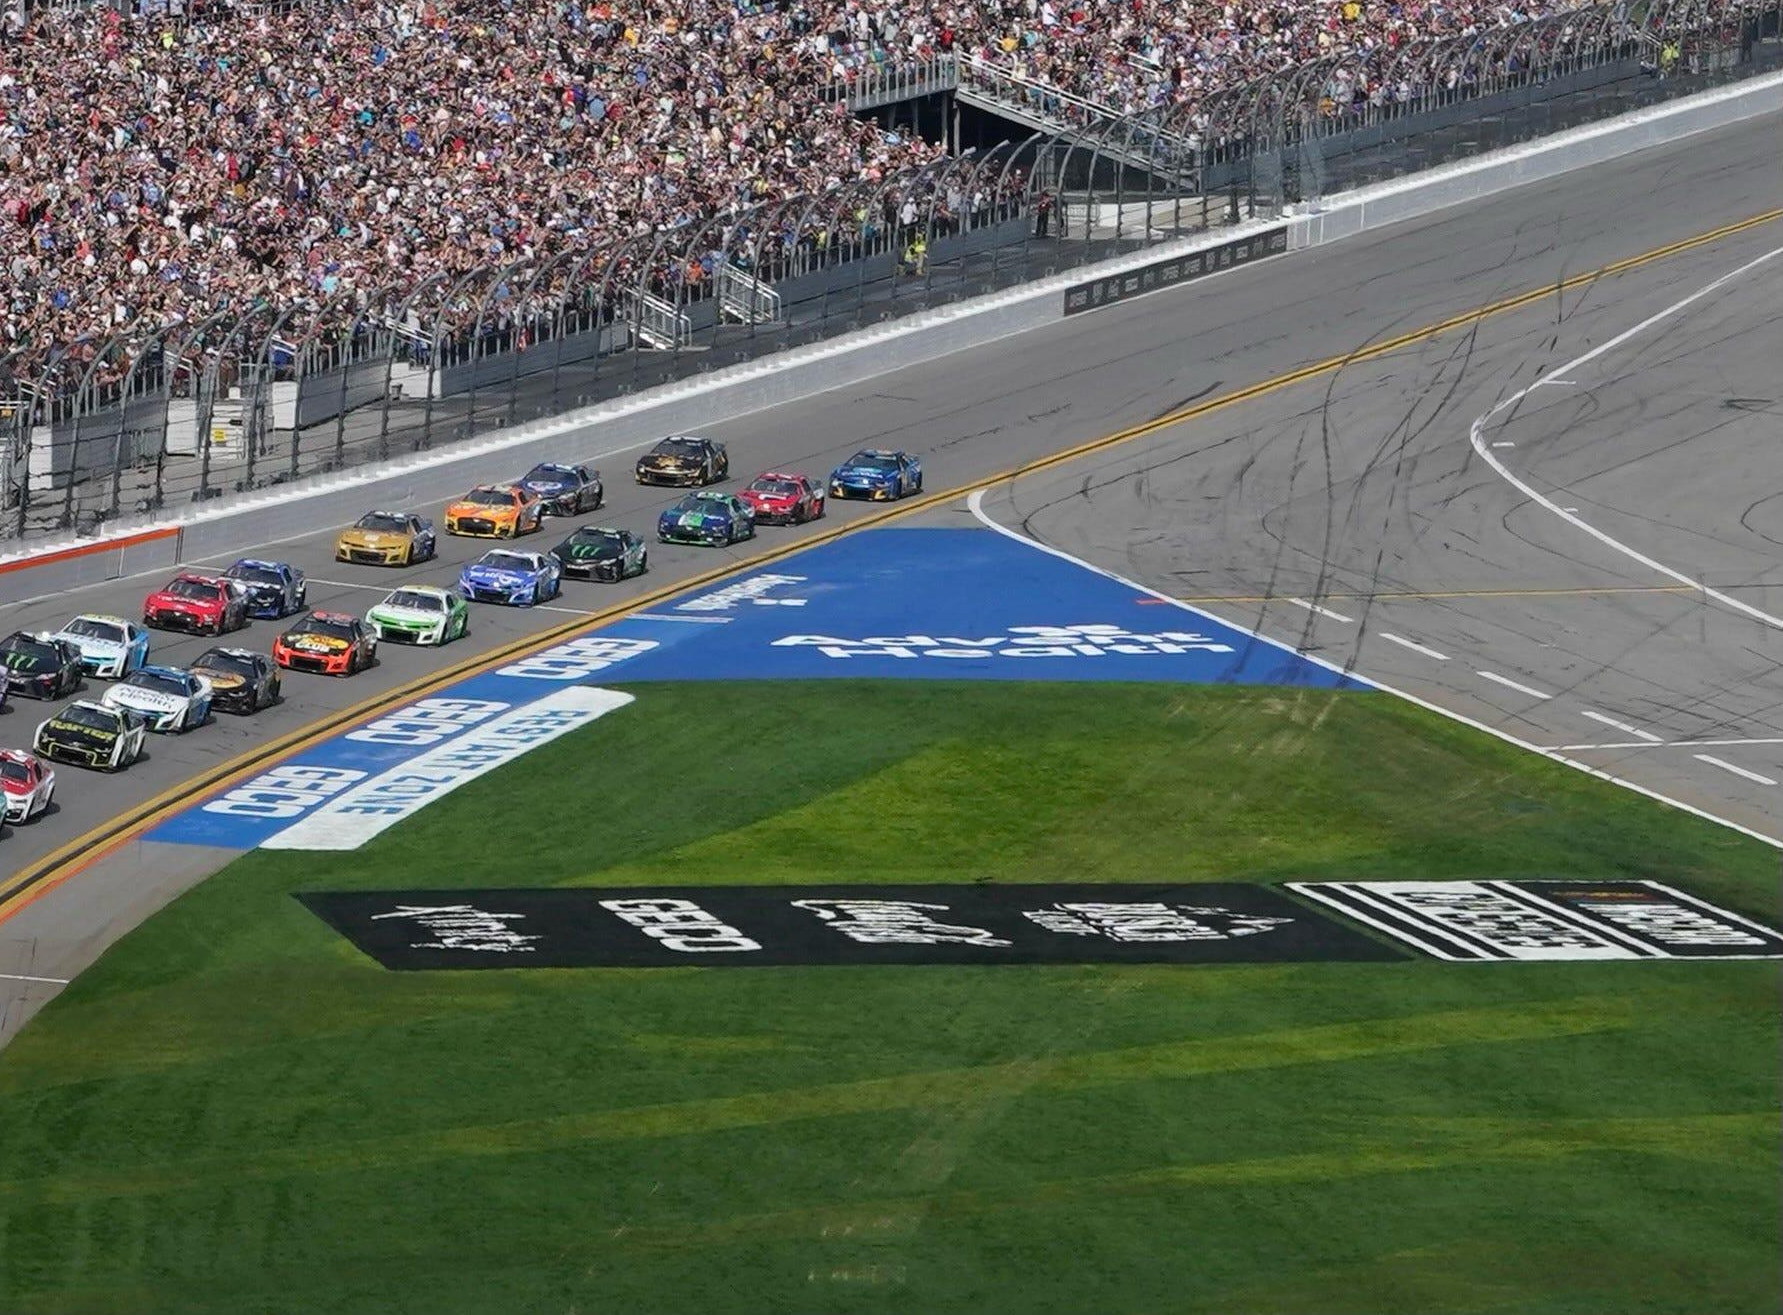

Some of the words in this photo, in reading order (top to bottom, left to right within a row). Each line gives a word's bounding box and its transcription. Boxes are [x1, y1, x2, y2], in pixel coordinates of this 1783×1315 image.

[495, 637, 660, 680] GEICO
[344, 697, 512, 746] GEICO
[422, 709, 590, 770] RESTART
[202, 765, 369, 818] GEICO
[335, 774, 458, 815] ZONE
[597, 897, 763, 952] GEICO
